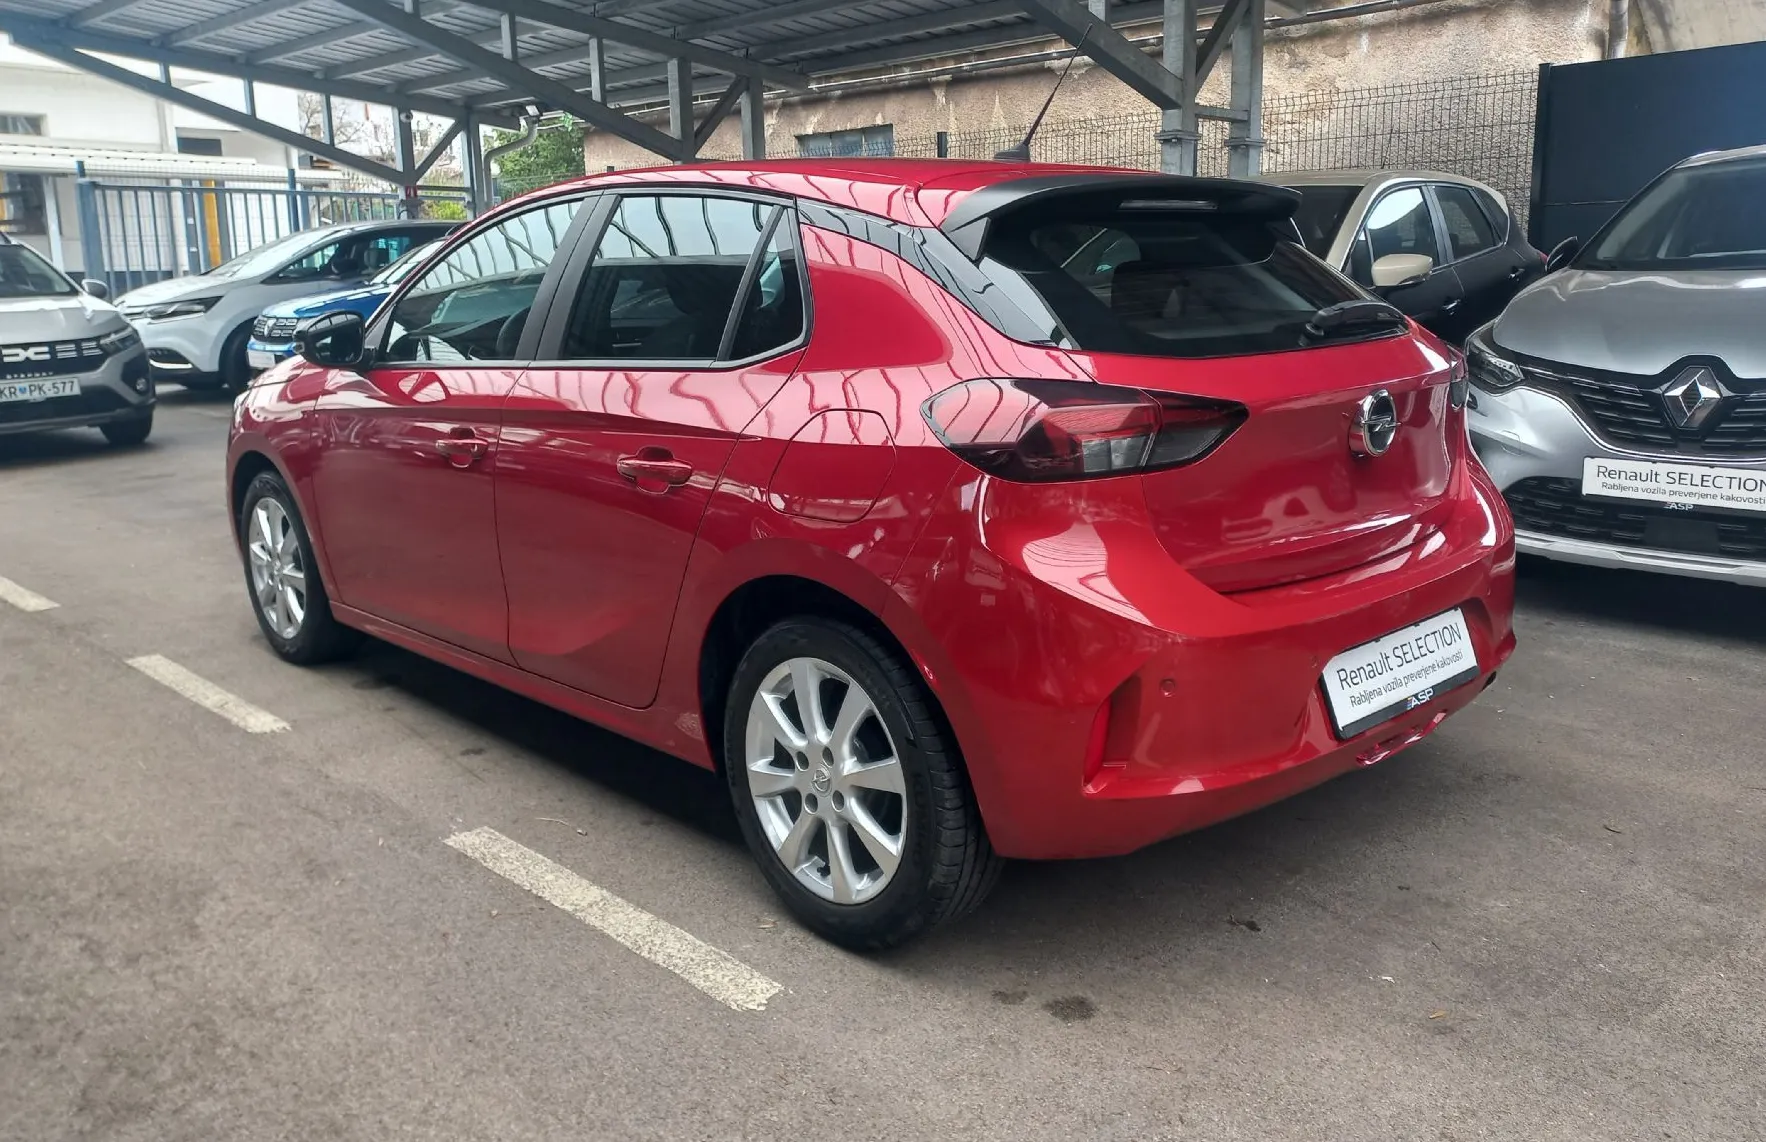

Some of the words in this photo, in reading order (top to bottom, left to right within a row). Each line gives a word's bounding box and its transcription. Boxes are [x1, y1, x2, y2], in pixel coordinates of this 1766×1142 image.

[0, 386, 17, 399] KR
[28, 380, 75, 397] PK-577
[1597, 465, 1661, 484] Renault
[1601, 482, 1639, 493] Rabljena
[1641, 487, 1666, 495] vozila
[1668, 489, 1718, 500] preverjene
[1720, 493, 1766, 505] kakovosti
[1337, 652, 1394, 690] Renault
[1392, 622, 1462, 668] SELECTION
[1350, 689, 1383, 708] Rabljena
[1382, 677, 1404, 694] vozila
[1403, 663, 1438, 688] preverjene
[1435, 648, 1463, 670] kakovosti
[1411, 688, 1434, 708] ASP
